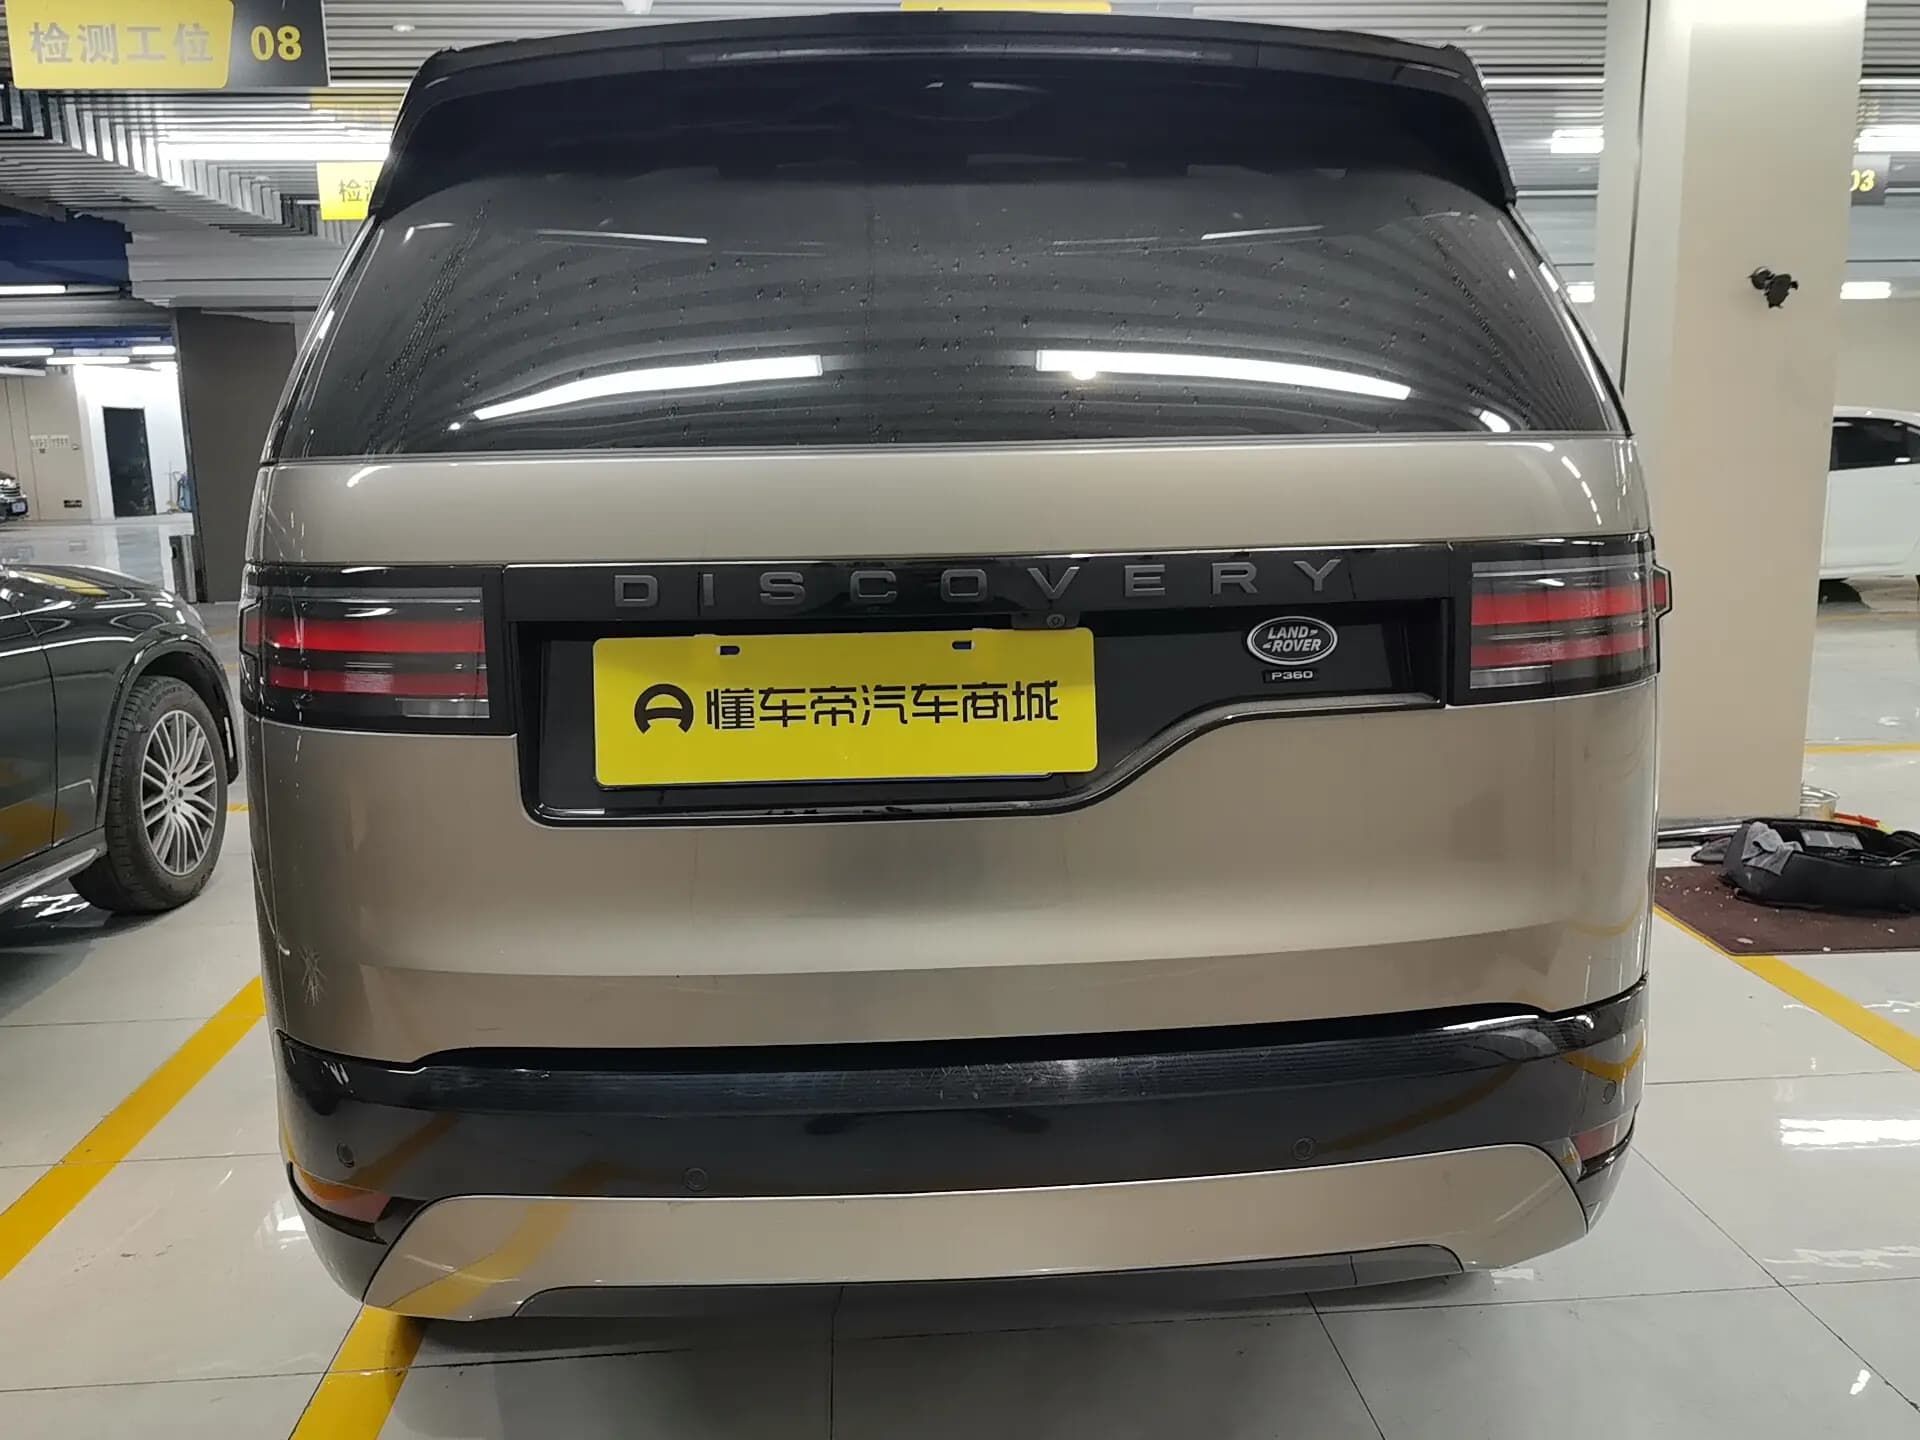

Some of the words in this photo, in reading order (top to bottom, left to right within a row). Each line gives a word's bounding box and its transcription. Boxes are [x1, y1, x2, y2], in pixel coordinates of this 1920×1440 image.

[29, 21, 214, 65] 检测工位
[250, 25, 302, 61] 08
[614, 559, 1342, 607] DISCOVERY
[1268, 626, 1309, 639] LAND
[1271, 638, 1321, 652] ROVER
[1271, 670, 1313, 680] P360
[706, 680, 1058, 730] 懂车帝汽车商城
